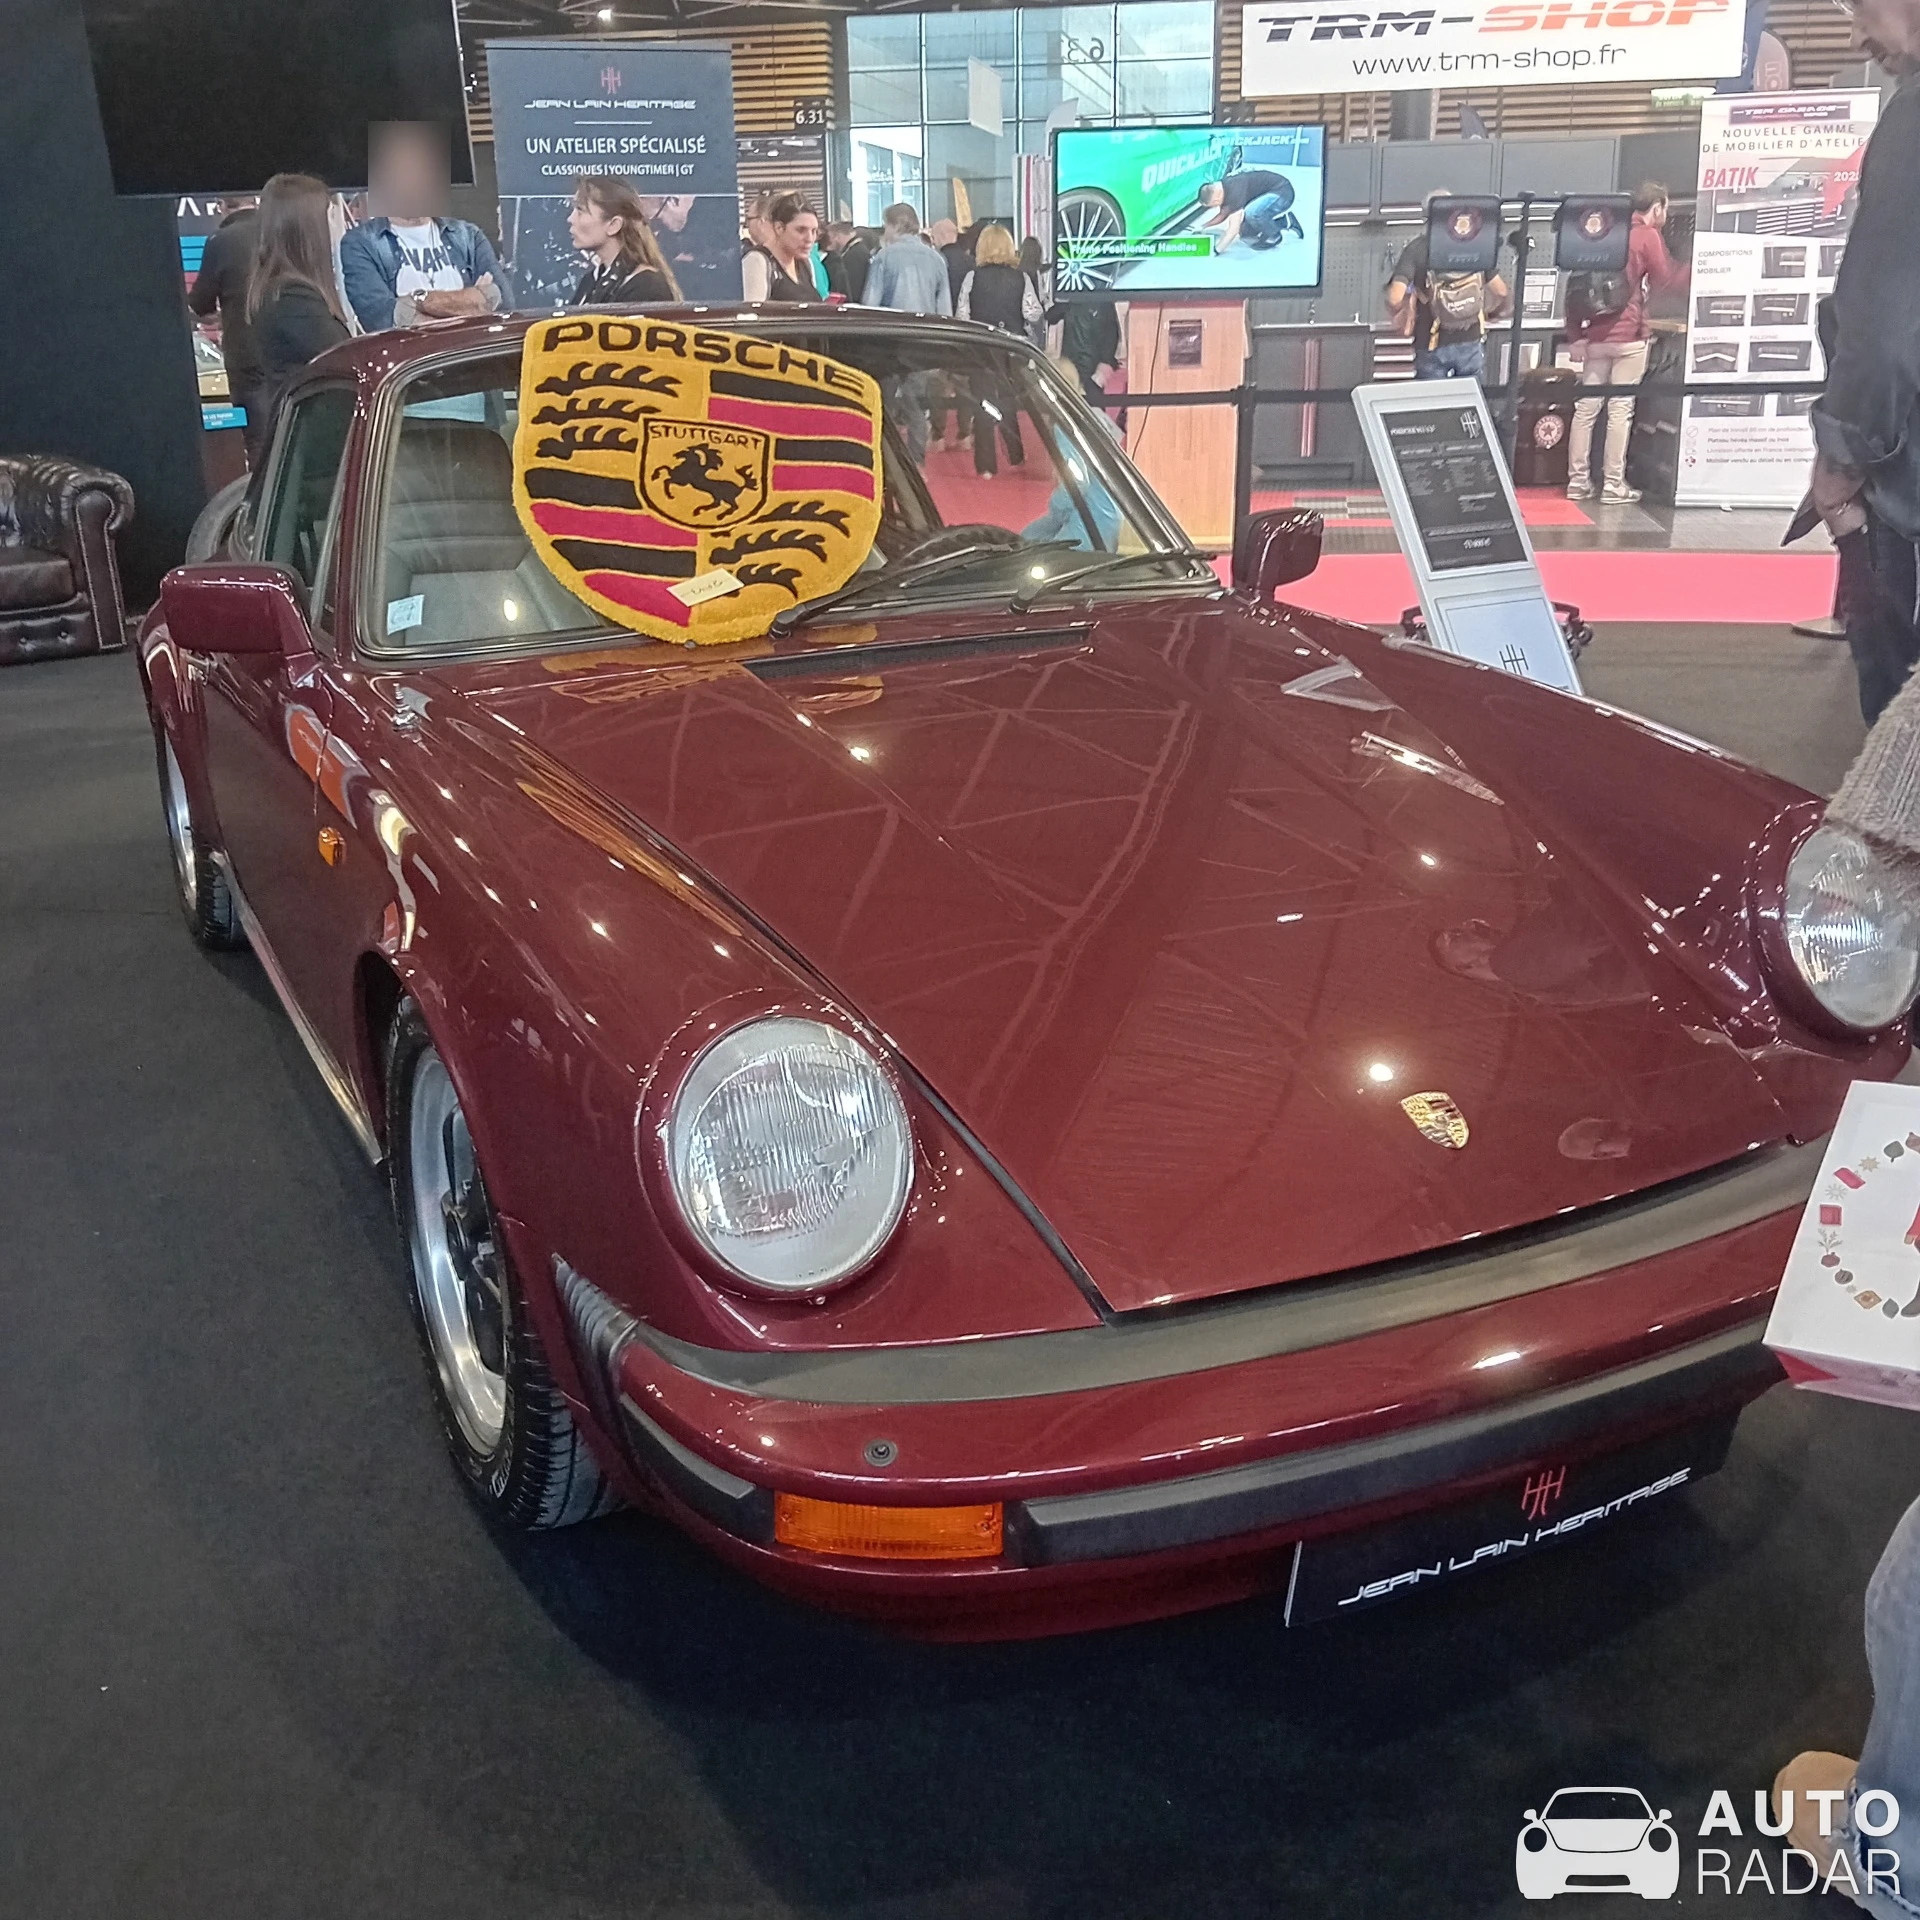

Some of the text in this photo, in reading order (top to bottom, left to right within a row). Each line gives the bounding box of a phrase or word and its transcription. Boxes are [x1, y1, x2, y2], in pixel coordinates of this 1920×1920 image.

[1258, 0, 1730, 43] TRM-SHOP
[1352, 44, 1627, 75] www.trm-shop.fr
[524, 100, 571, 108] JEAN
[796, 109, 825, 124] 6.31
[1722, 124, 1855, 138] NOUVELLE GAMME
[526, 135, 707, 154] UN ATELIER SPÉCIALISÉ
[1702, 137, 1864, 153] DE MOBILIER D'ATELIE
[541, 164, 694, 176] CLASSIQUES YOUNGTIMER GT
[1702, 166, 1759, 188] BATIK
[1158, 242, 1198, 252] Handles
[542, 322, 866, 397] PORSCHE
[649, 423, 763, 449] STUTTGART
[1338, 1467, 1691, 1605] JEAN LAIN HERITAGE
